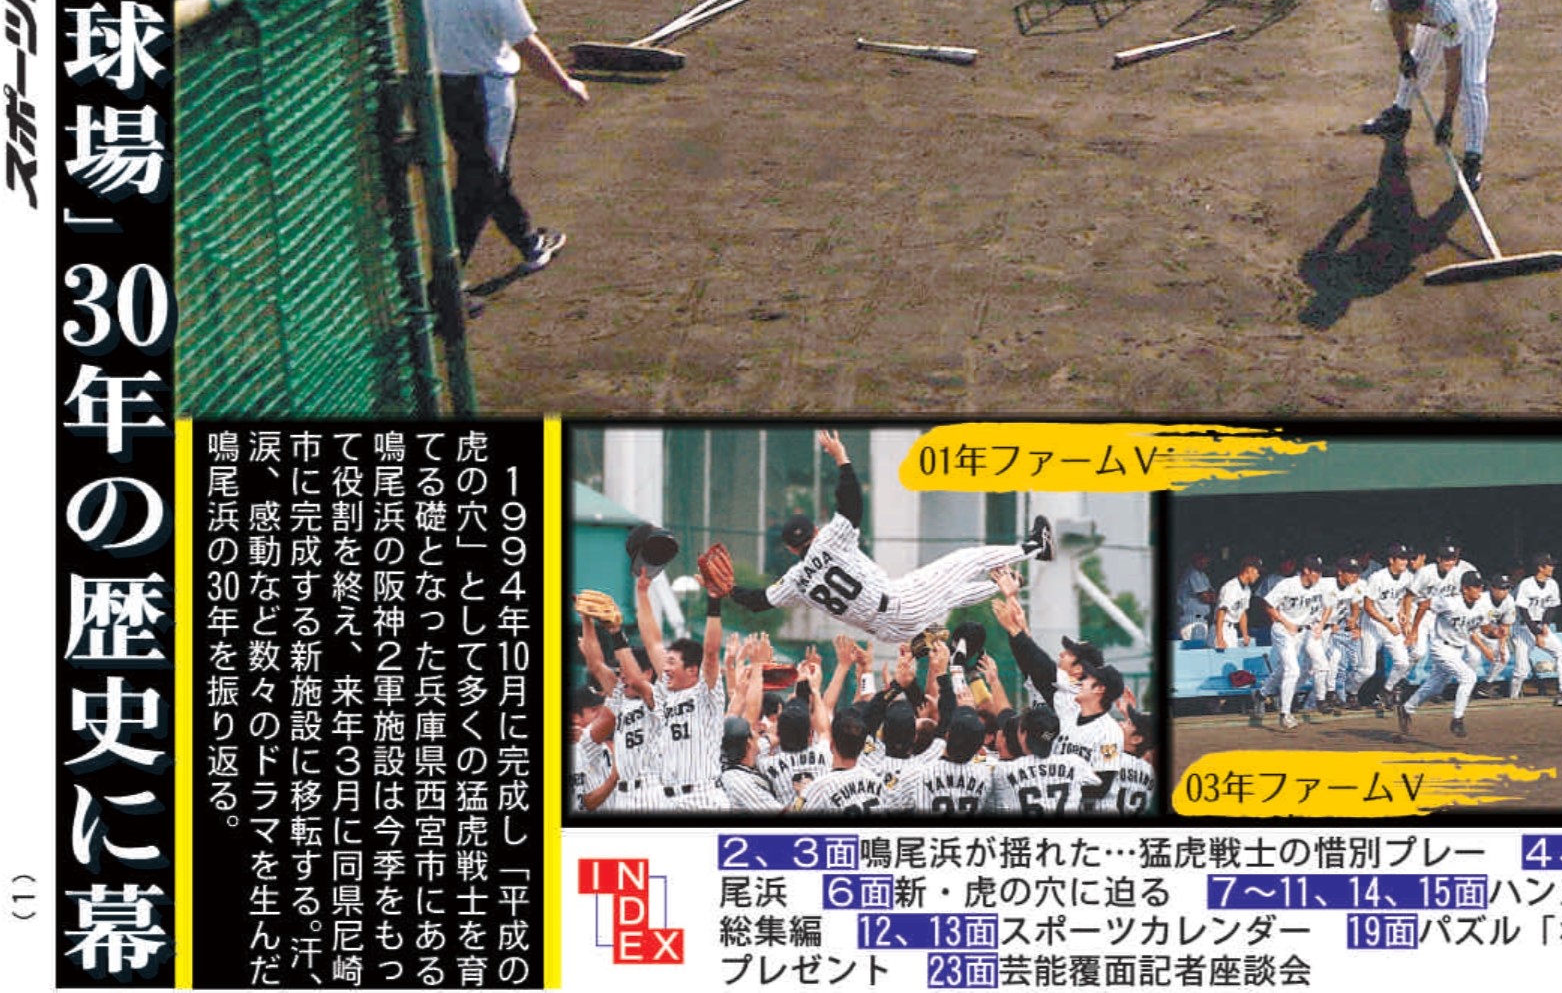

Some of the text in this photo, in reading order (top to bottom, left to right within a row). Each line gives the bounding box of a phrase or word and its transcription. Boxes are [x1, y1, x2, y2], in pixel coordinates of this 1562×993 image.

[207, 431, 240, 827] 鳴尾浜の30年を振り返る。
[809, 565, 864, 616] 80
[249, 431, 281, 985] 涙、感動など数々のドラマを生んだ
[290, 431, 322, 986] 市に完成する新施設に移転する。汗、
[332, 432, 364, 986] て役割を終え、来年3月に同県尼崎
[373, 431, 405, 983] 鳴尾浜の阪神2軍施設は今季をもっ
[415, 432, 447, 985] てる礎となった兵庫県西宮市にある
[456, 431, 489, 986] 虎の穴」として多くの猛虎戦士を育
[498, 467, 530, 984] 1994年10月に完成し「平成の
[625, 729, 644, 749] 65
[670, 723, 690, 741] 61
[1007, 763, 1075, 786] MATSUDA
[1018, 782, 1070, 815] 67
[720, 876, 787, 908] 尾浜
[720, 915, 822, 947] 総集編
[721, 953, 888, 986] プレゼント
